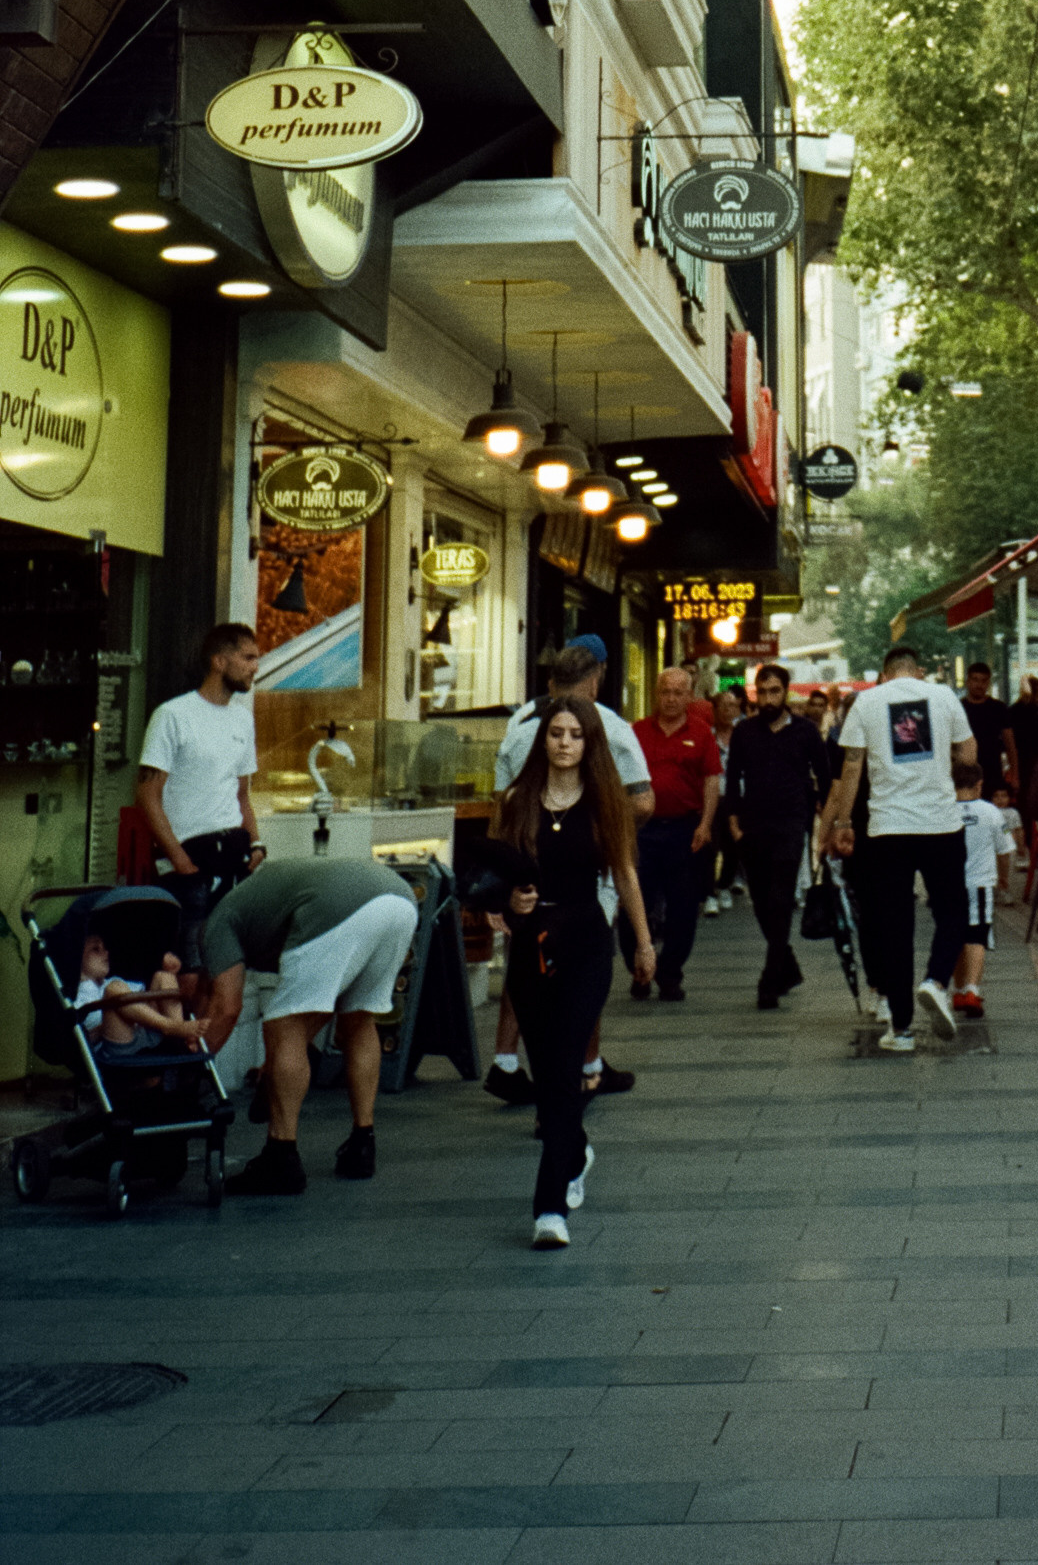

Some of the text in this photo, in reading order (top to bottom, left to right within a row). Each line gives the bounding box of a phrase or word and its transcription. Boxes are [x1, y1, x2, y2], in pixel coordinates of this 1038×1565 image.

[270, 82, 356, 111] D&P
[239, 117, 382, 145] perfumum
[683, 212, 776, 230] HACI HAKKI USTA
[707, 232, 755, 241] TATLILARI
[21, 301, 76, 376] D&P
[0, 388, 87, 450] perfumum
[274, 490, 367, 509] HACI HAKKI USTA
[300, 510, 341, 518] TATLILARI
[434, 549, 477, 570] TERAS
